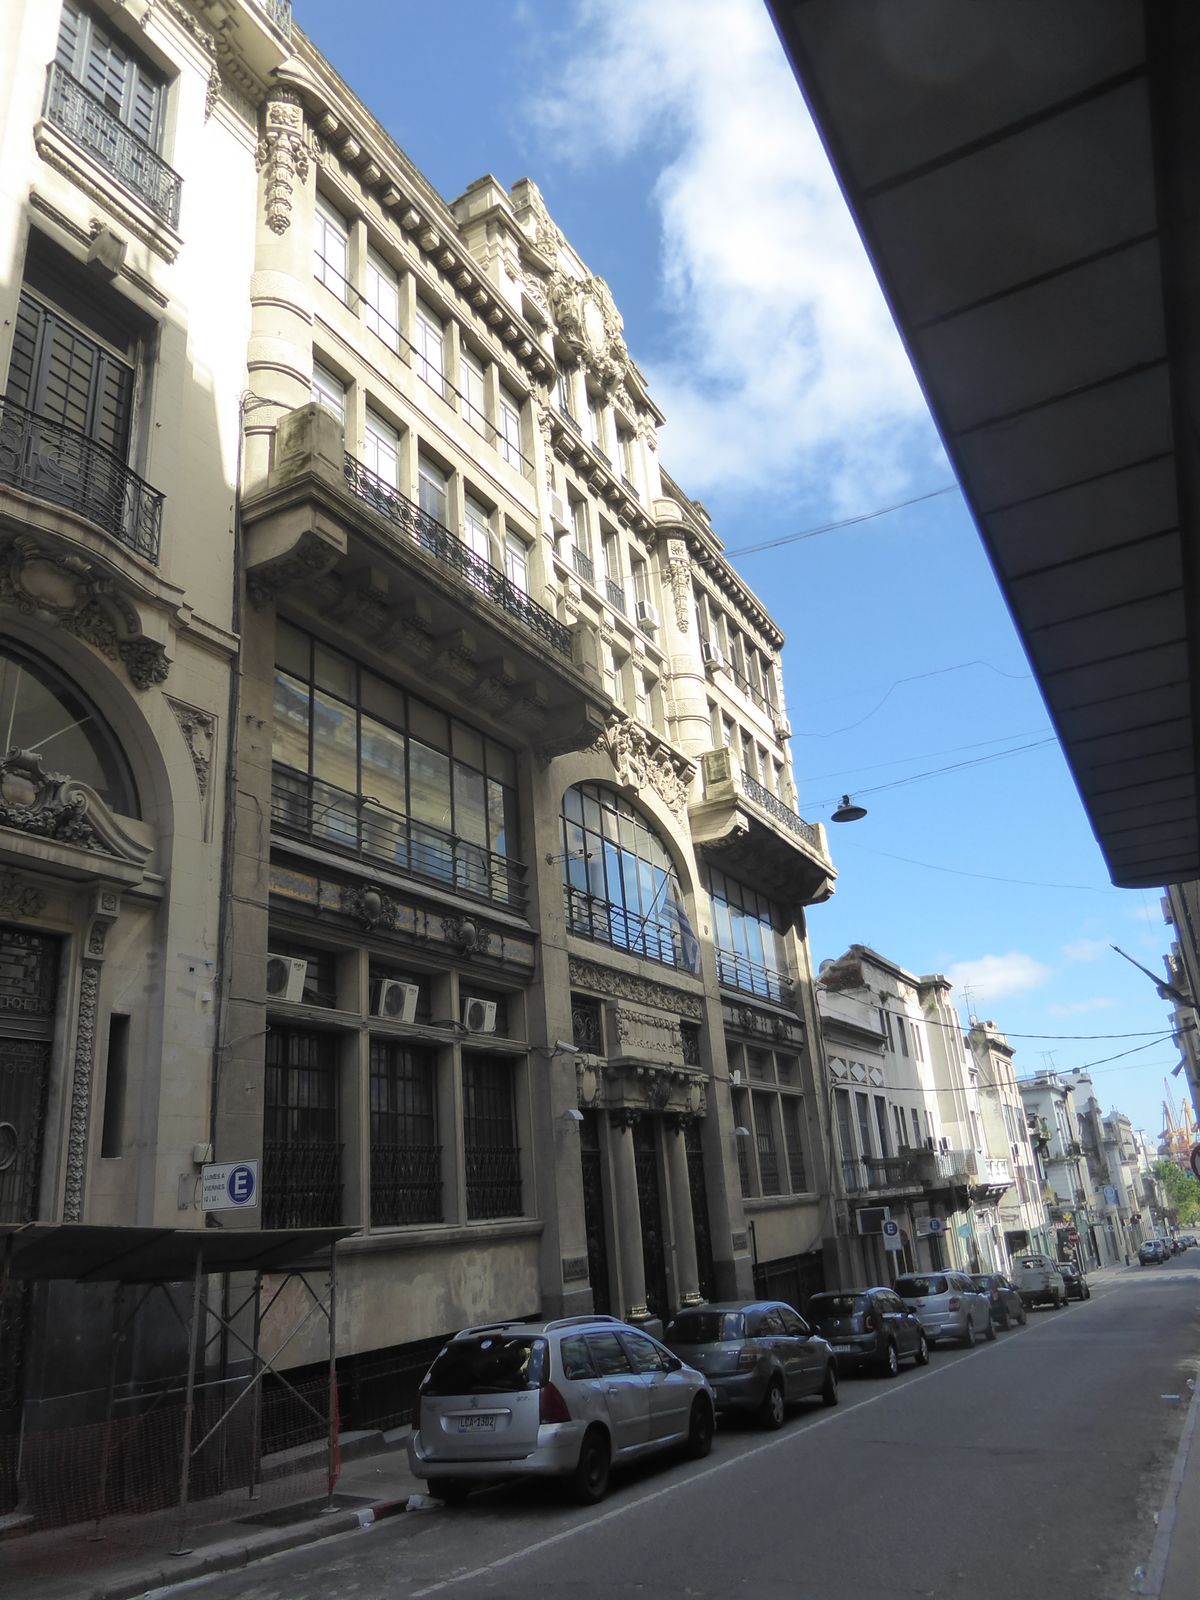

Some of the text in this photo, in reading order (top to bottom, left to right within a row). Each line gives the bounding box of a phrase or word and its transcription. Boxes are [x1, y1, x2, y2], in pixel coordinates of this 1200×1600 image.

[204, 1173, 221, 1181] LUNES
[234, 1171, 248, 1195] E
[887, 1224, 895, 1234] E
[931, 1220, 938, 1229] E
